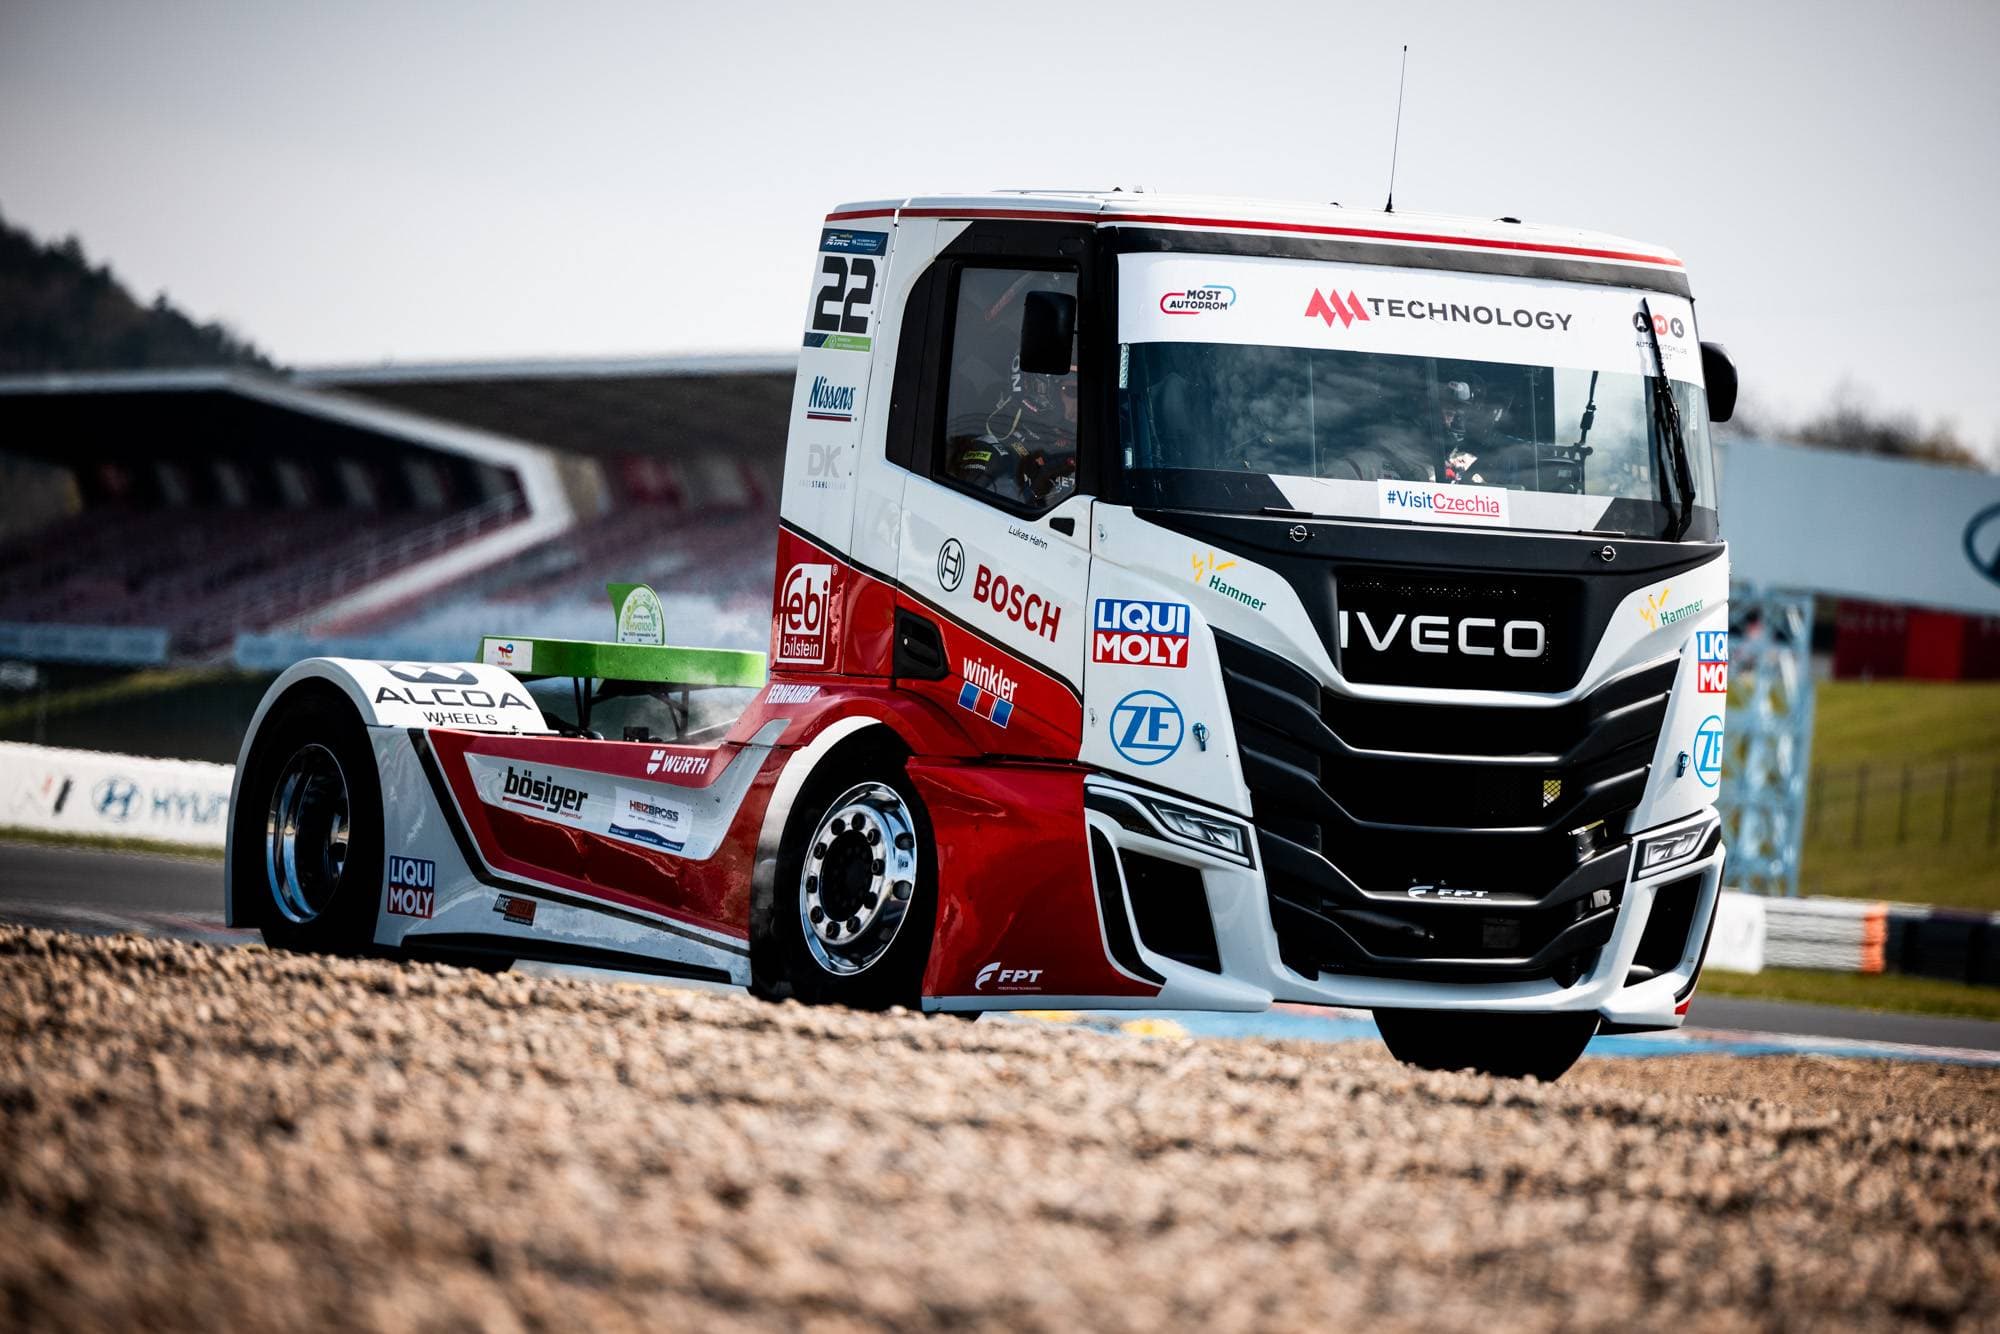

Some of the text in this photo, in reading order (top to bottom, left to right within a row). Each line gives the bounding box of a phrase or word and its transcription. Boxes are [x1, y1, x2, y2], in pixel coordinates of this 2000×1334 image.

[812, 256, 876, 334] 22
[1169, 300, 1228, 310] AUTODROM
[1187, 290, 1221, 300] MOST
[1367, 297, 1572, 332] TECHNOLOGY
[808, 376, 853, 410] Nissens
[808, 443, 842, 478] DK
[1387, 490, 1500, 515] #VisitCzechia
[1008, 525, 1048, 550] Lukas Hahn
[973, 563, 1062, 643] BOSCH
[1209, 575, 1267, 611] Hammer
[1097, 602, 1186, 634] LIQUI
[1660, 599, 1704, 626] Hammer
[783, 636, 820, 657] bilstein
[1096, 633, 1188, 665] MOLY
[1338, 610, 1546, 658] IVECO
[963, 657, 1018, 701] winkler
[375, 687, 532, 710] ALCOA
[423, 711, 497, 725] WHEELS
[1118, 705, 1178, 750] ZF
[1698, 730, 1724, 772] ZF
[504, 766, 588, 813] bösiger
[629, 800, 679, 821] HEIZBROSS
[391, 859, 433, 886] LIQUI
[389, 887, 433, 916] MOLY
[998, 969, 1043, 983] FPT
